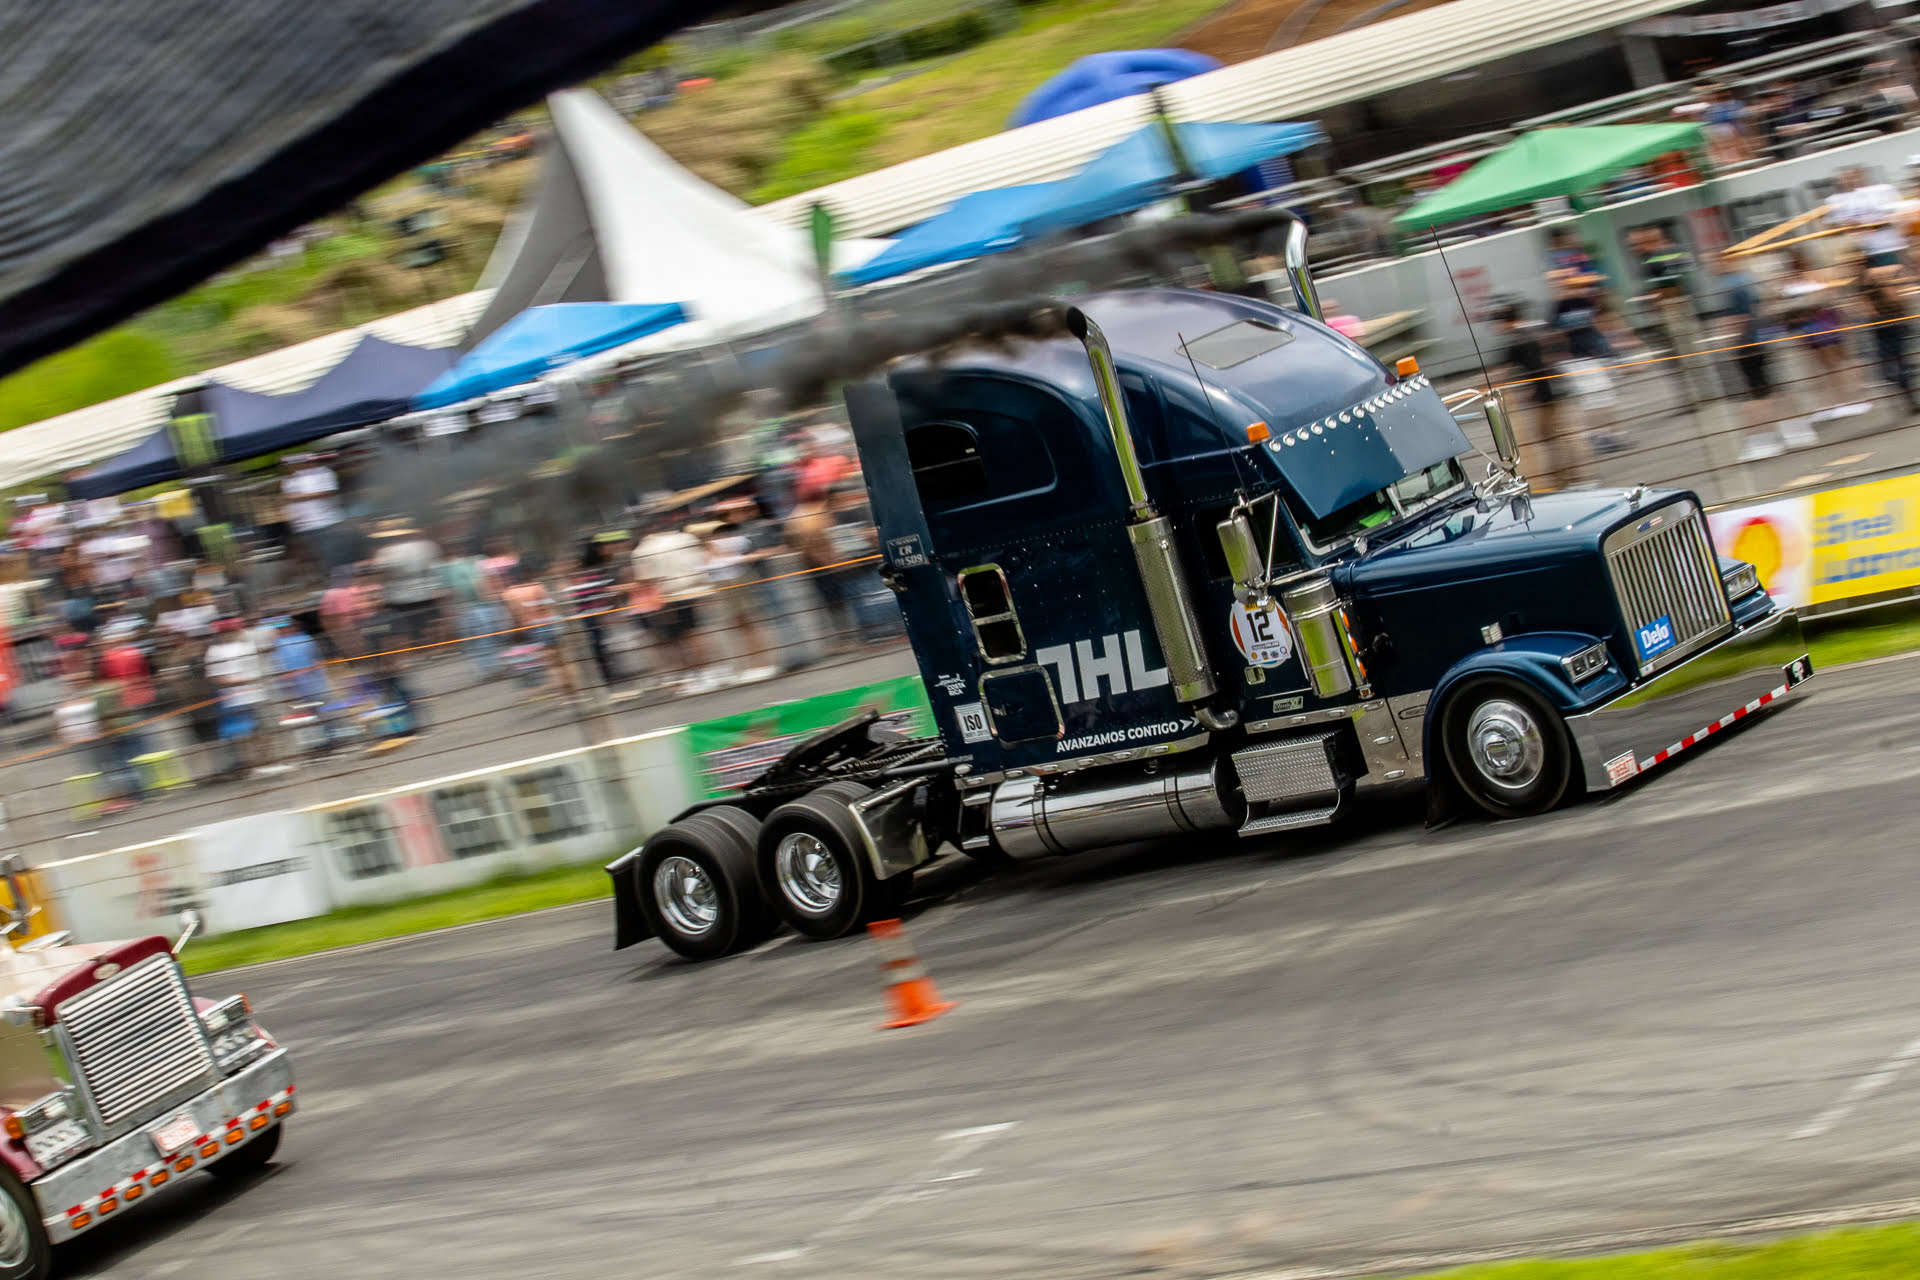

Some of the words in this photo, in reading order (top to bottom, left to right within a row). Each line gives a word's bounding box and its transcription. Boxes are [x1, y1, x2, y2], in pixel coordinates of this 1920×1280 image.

[1245, 610, 1275, 643] 12
[1640, 623, 1670, 649] Delo
[963, 714, 983, 731] ISO
[1056, 729, 1126, 753] AVANZAMOS
[1127, 721, 1179, 741] CONTIGO
